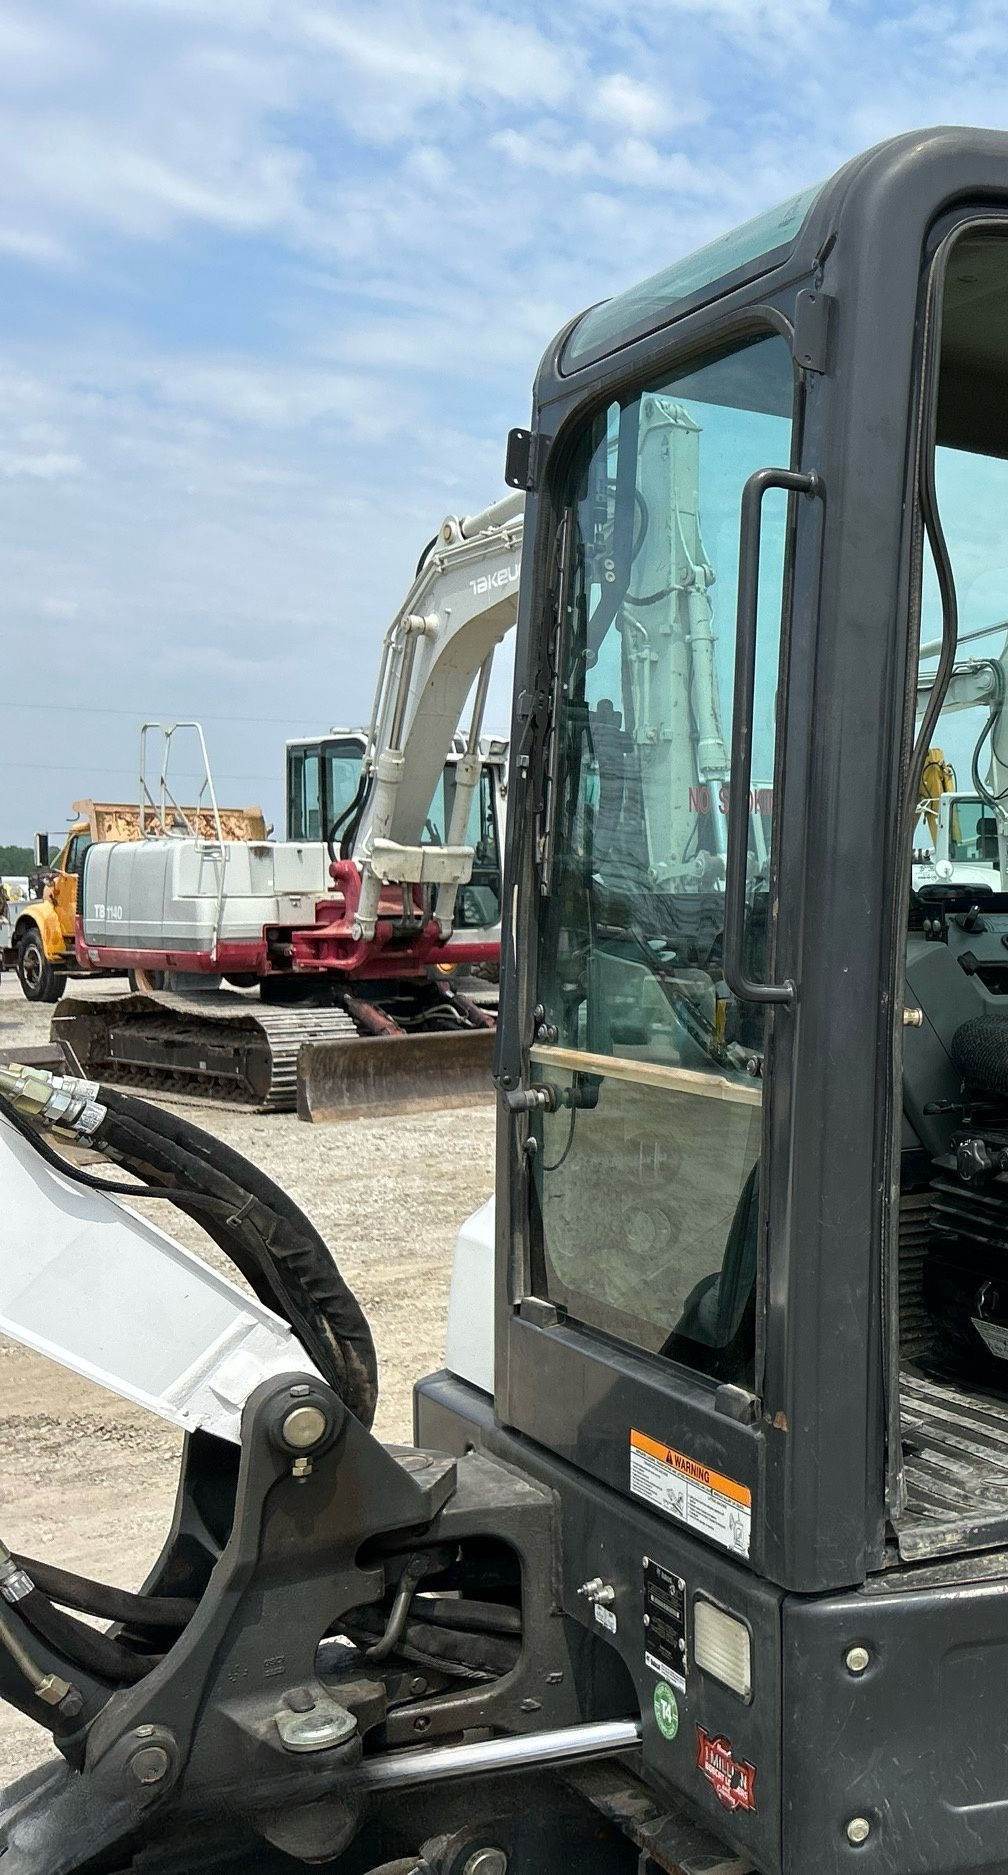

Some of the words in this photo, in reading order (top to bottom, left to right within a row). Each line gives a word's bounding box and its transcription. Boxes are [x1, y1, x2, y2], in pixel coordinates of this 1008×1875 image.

[688, 786, 711, 815] NO
[94, 904, 105, 919] TB
[106, 905, 123, 920] 1140
[674, 1455, 710, 1484] WARNING
[660, 1698, 672, 1723] T4
[710, 1750, 748, 1791] MILLIN
